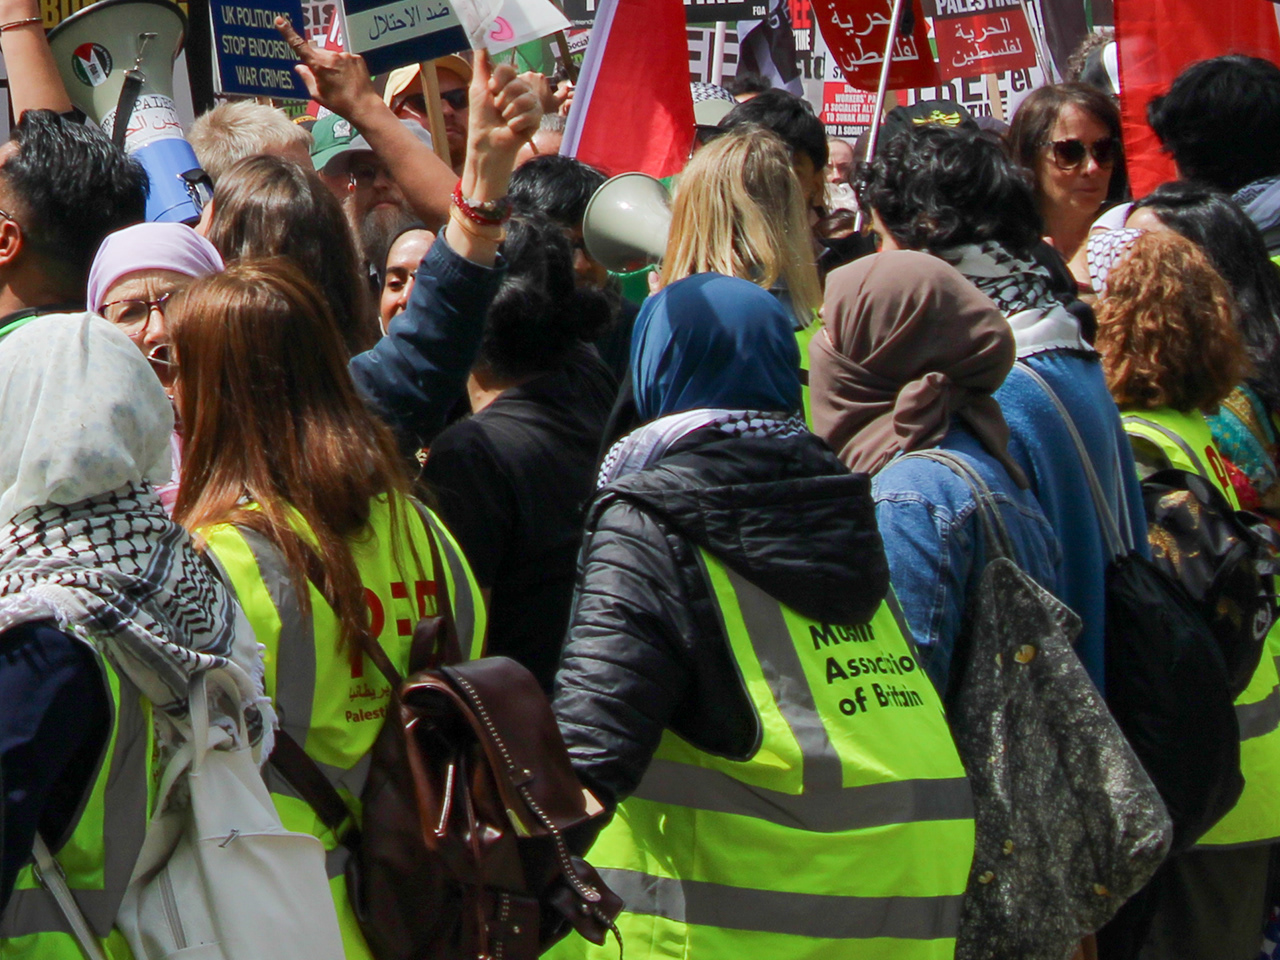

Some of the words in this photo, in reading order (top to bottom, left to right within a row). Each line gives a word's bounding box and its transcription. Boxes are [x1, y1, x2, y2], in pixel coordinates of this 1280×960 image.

[221, 4, 237, 24] UK
[426, 2, 450, 22] ضد
[752, 4, 767, 17] FOA
[954, 17, 1011, 43] الحرية
[221, 34, 246, 55] STOP
[567, 36, 590, 51] Social
[952, 37, 1023, 68] لفلسطين
[235, 65, 259, 86] WAR
[259, 68, 295, 90] CRIMES.
[838, 686, 868, 717] of
[871, 682, 924, 708] Britain
